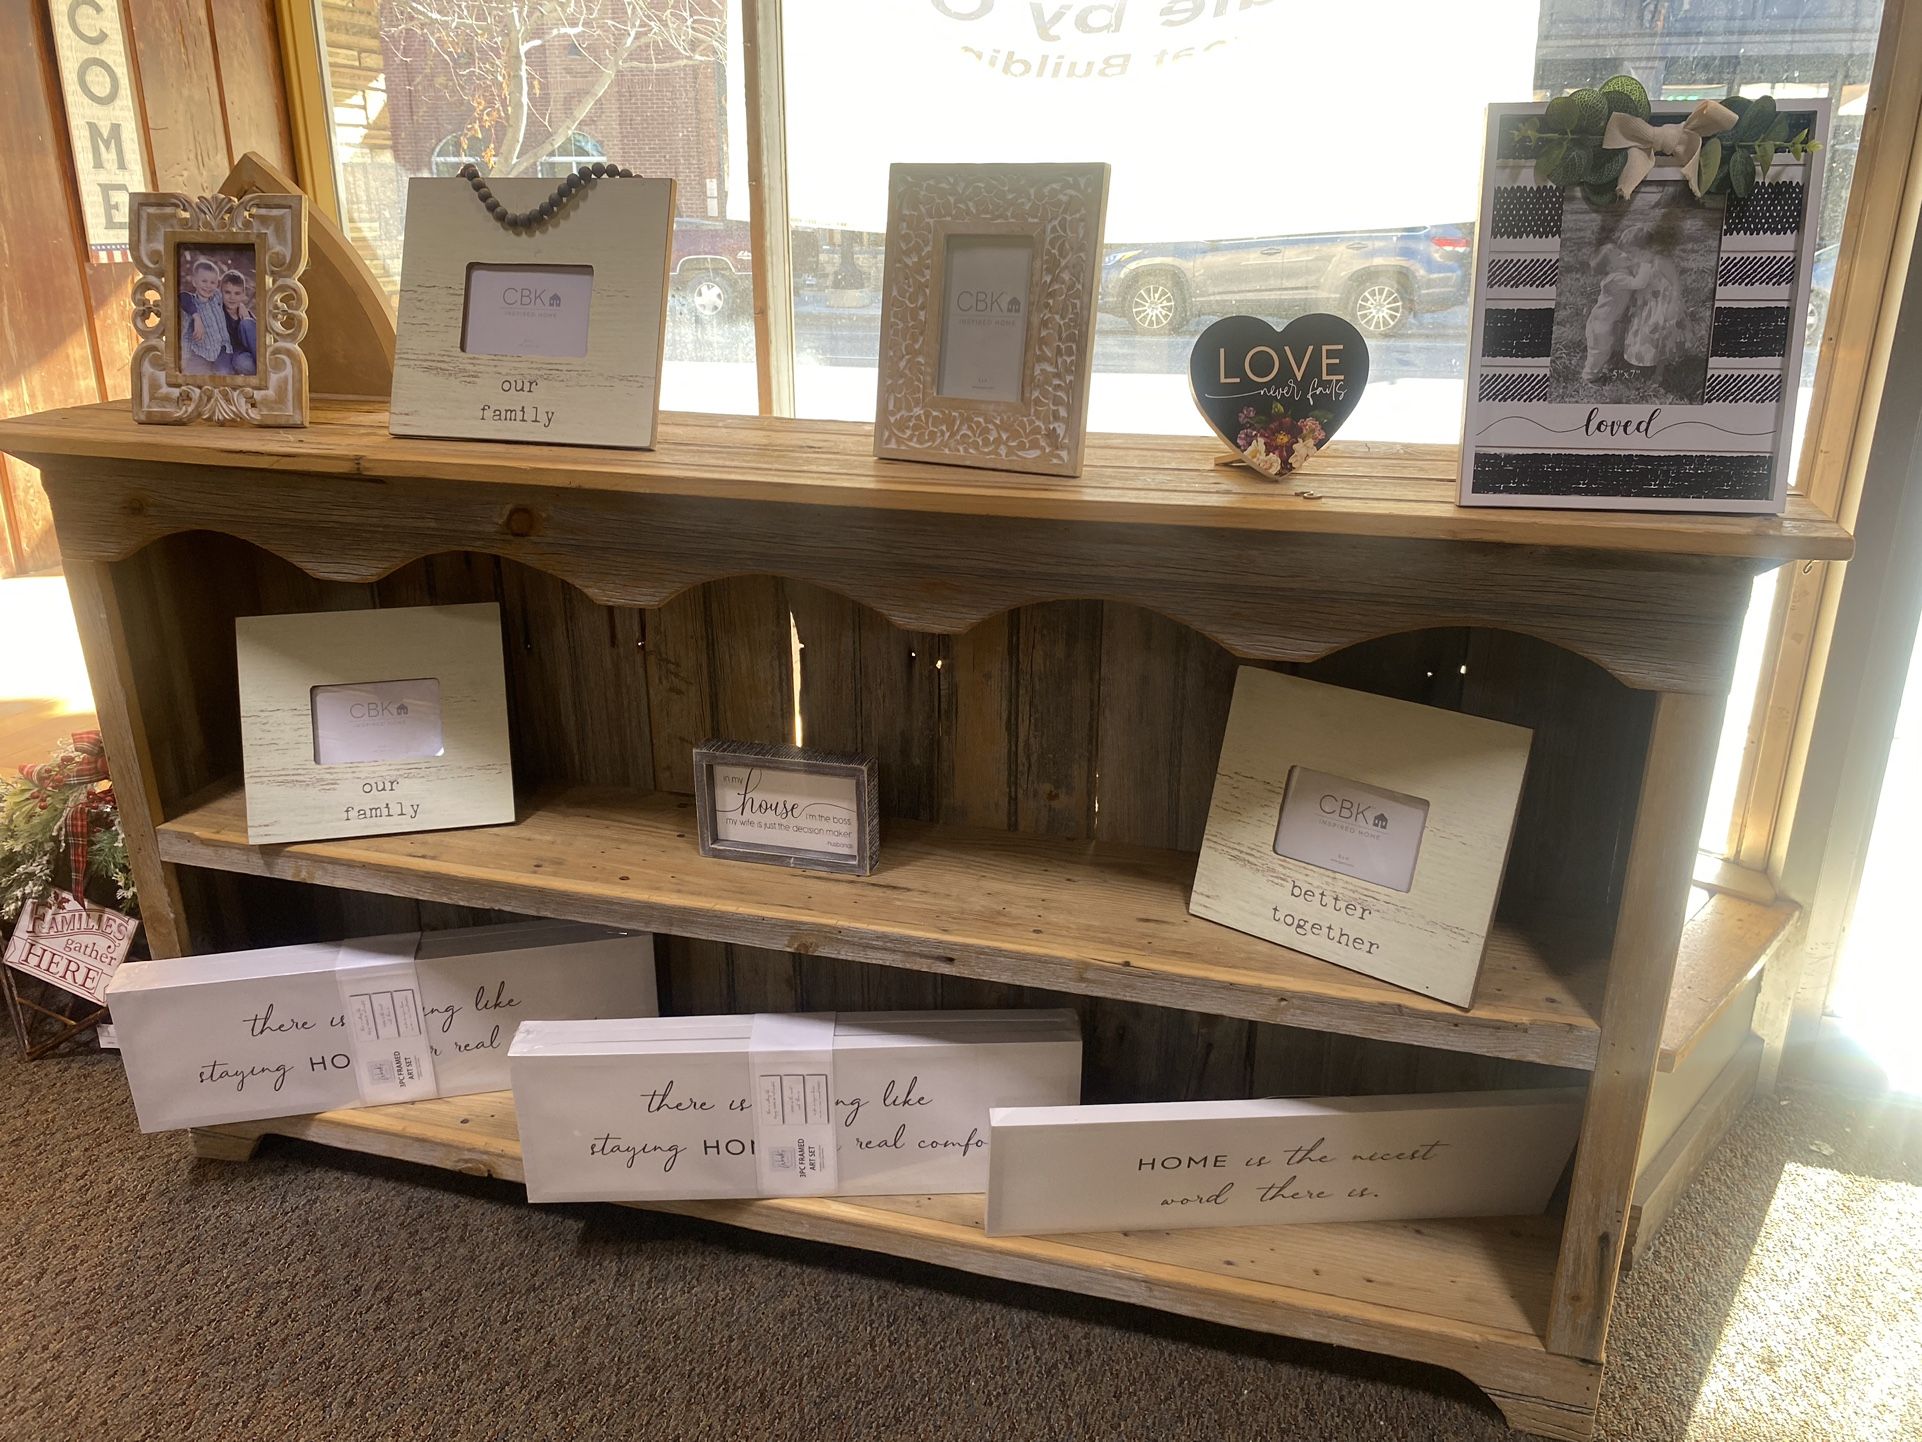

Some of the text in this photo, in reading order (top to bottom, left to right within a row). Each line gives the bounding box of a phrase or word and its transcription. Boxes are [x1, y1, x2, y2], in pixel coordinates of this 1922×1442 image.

[502, 287, 546, 306] CBK
[957, 290, 1006, 313] CBK
[1219, 344, 1345, 384] LOVE
[501, 379, 538, 393] our
[480, 404, 555, 428] family
[1584, 407, 1662, 439] loved
[349, 701, 394, 719] CBK
[362, 779, 399, 794] our
[731, 777, 744, 785] my
[736, 767, 802, 820] house
[818, 814, 831, 823] the
[832, 815, 852, 826] boss
[1319, 794, 1371, 825] CBK
[344, 802, 420, 821] family
[725, 818, 853, 838] my wife is just the decision maker
[1318, 819, 1382, 841] INSPIRED HOME
[1290, 880, 1372, 921] better
[26, 901, 128, 942] FAMILIES
[1271, 905, 1380, 955] together
[63, 938, 117, 967] gather
[20, 942, 100, 993] HERE
[242, 1003, 316, 1037] there
[330, 1015, 347, 1028] is
[474, 980, 522, 1011] like
[199, 1060, 295, 1092] staying
[309, 1053, 351, 1072] HO
[454, 1024, 501, 1053] real
[393, 1050, 404, 1076] FRAMED
[404, 1057, 415, 1080] ART SET
[640, 1080, 716, 1114] there
[729, 1098, 752, 1112] is
[883, 1076, 934, 1107] like
[590, 1132, 688, 1173] staying
[855, 1123, 906, 1150] real
[917, 1127, 989, 1158] comfo
[797, 1138, 806, 1166] FRAMED
[808, 1145, 816, 1171] ART SET
[1137, 1137, 1452, 1171] HOME is the nicest
[1160, 1175, 1379, 1207] word there is.
